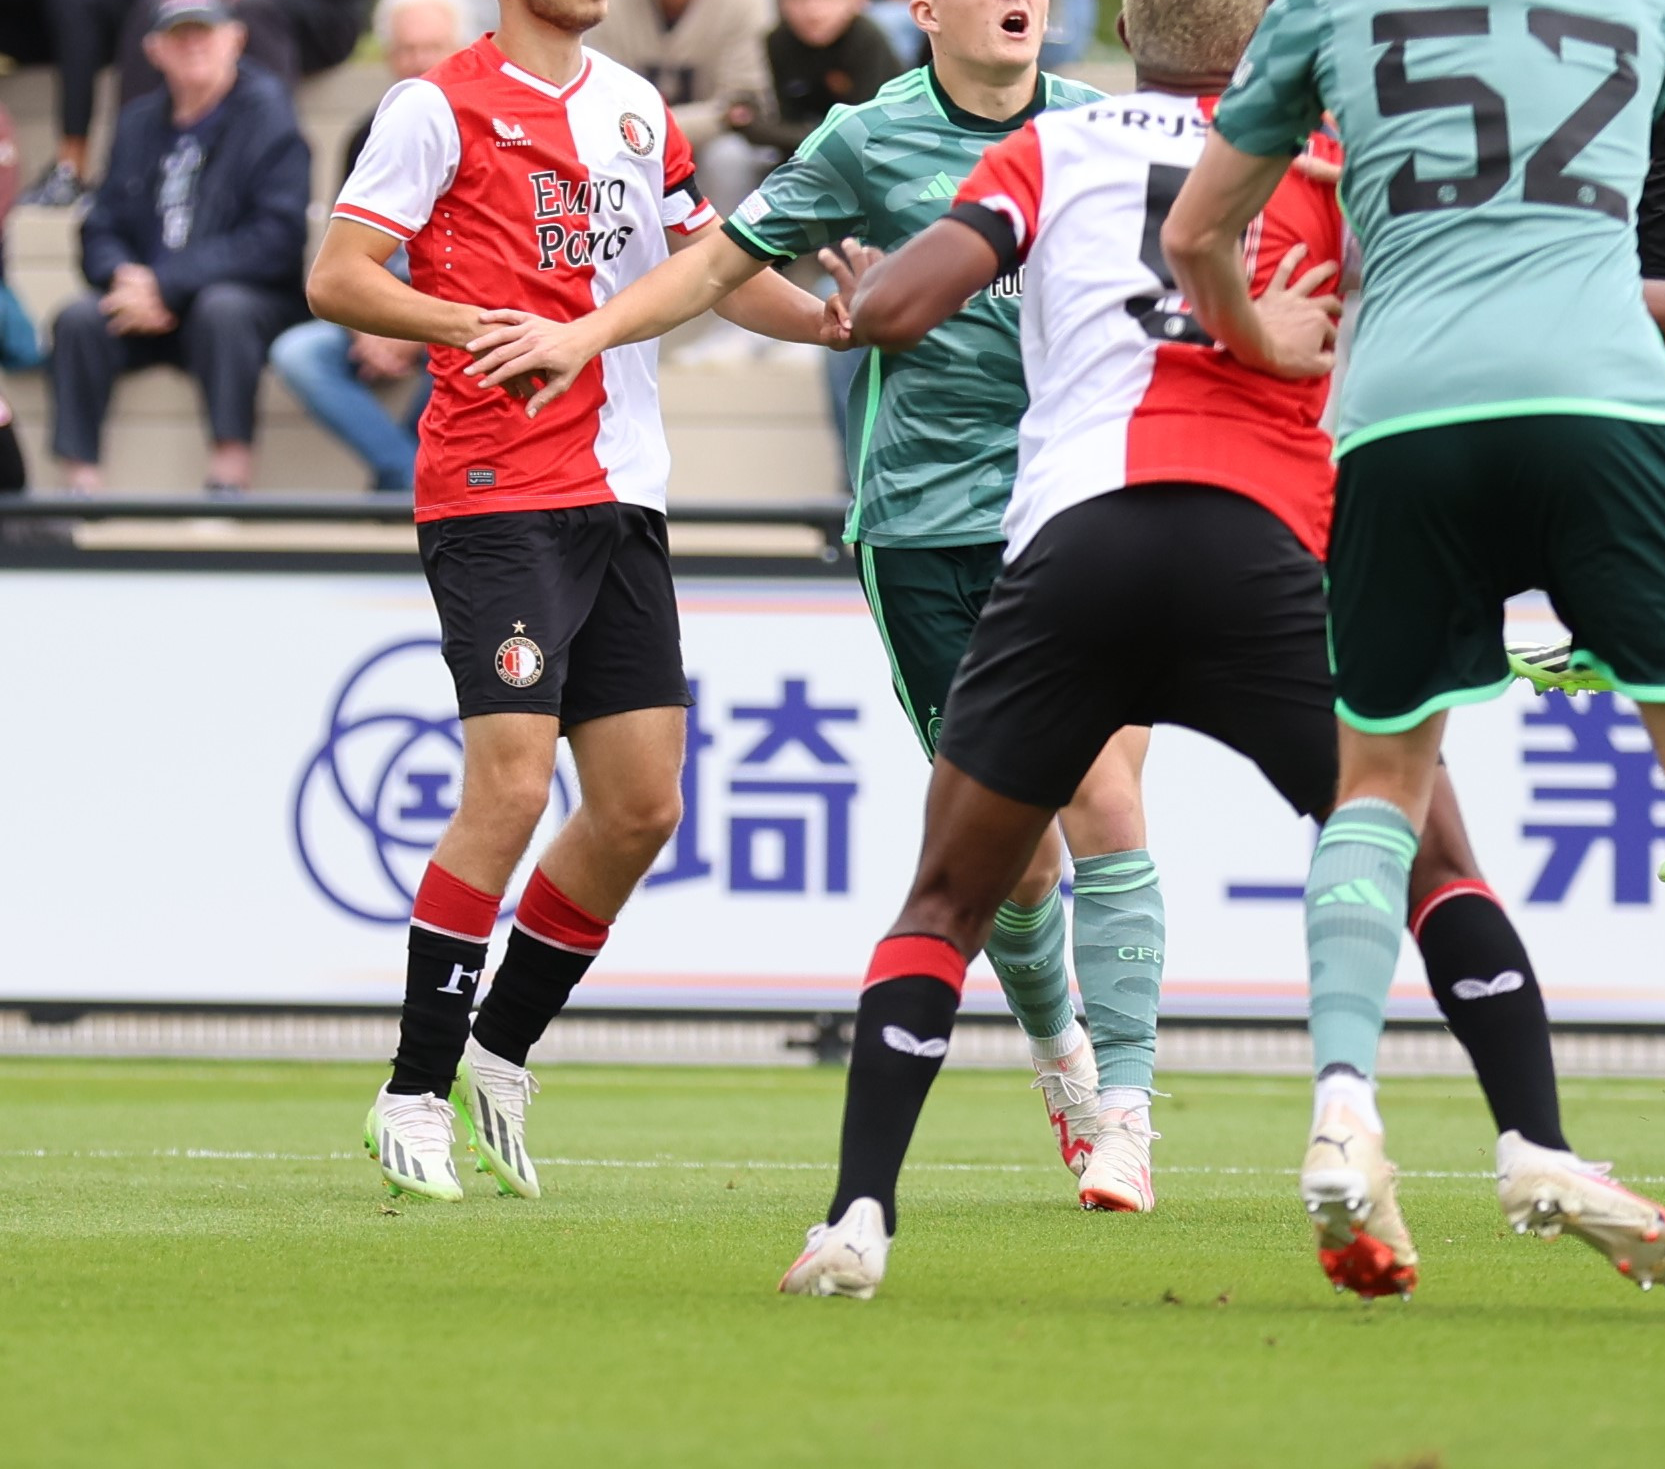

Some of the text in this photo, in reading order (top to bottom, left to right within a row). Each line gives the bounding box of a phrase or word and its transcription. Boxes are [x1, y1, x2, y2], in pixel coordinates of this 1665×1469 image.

[1372, 5, 1640, 224] 52
[530, 171, 626, 218] Euro
[537, 223, 634, 269] Parcs
